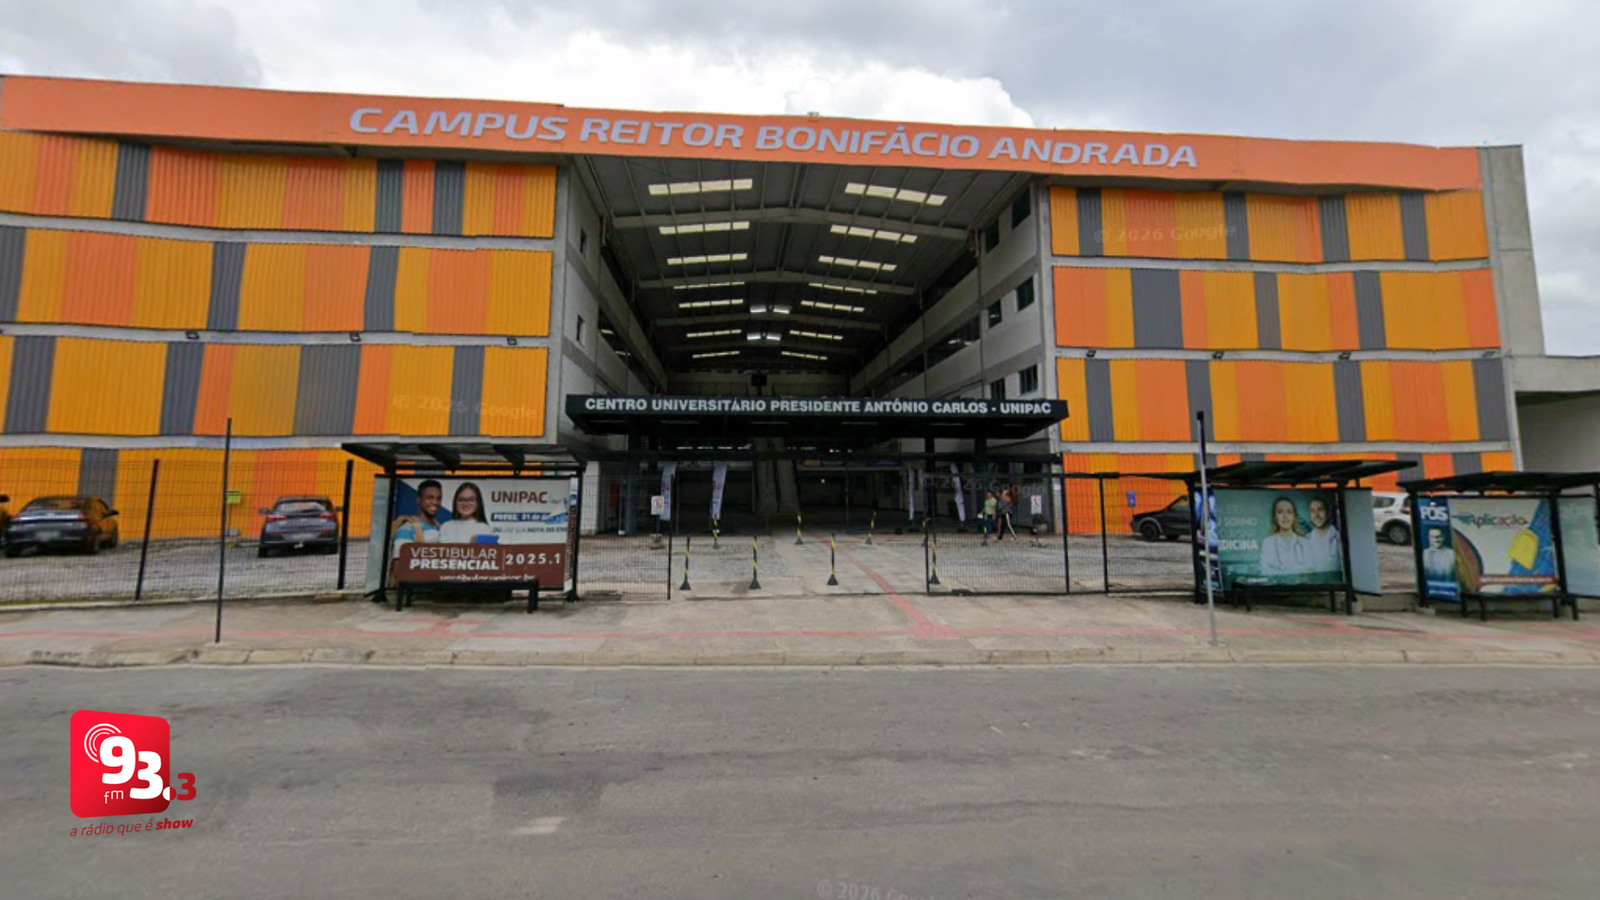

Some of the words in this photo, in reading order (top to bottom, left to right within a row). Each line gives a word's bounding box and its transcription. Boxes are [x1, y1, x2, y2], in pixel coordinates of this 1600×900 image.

[349, 107, 568, 141] CAMPUS
[579, 118, 744, 148] REITOR
[755, 124, 980, 158] BONIFÁCIO
[987, 137, 1198, 168] ANDRADA
[585, 397, 647, 411] CENTRO
[652, 397, 766, 412] UNIVERSITÁRIO
[770, 400, 860, 413] PRESIDENTE
[864, 398, 928, 414] ANTÔNIO
[932, 402, 988, 414] CARLOS
[1000, 402, 1052, 414] UNIPAC
[491, 490, 548, 504] UNIPAC
[411, 547, 497, 559] VESTIBULAR
[505, 553, 561, 565] 2025.1
[410, 559, 499, 570] PRESENCIAL
